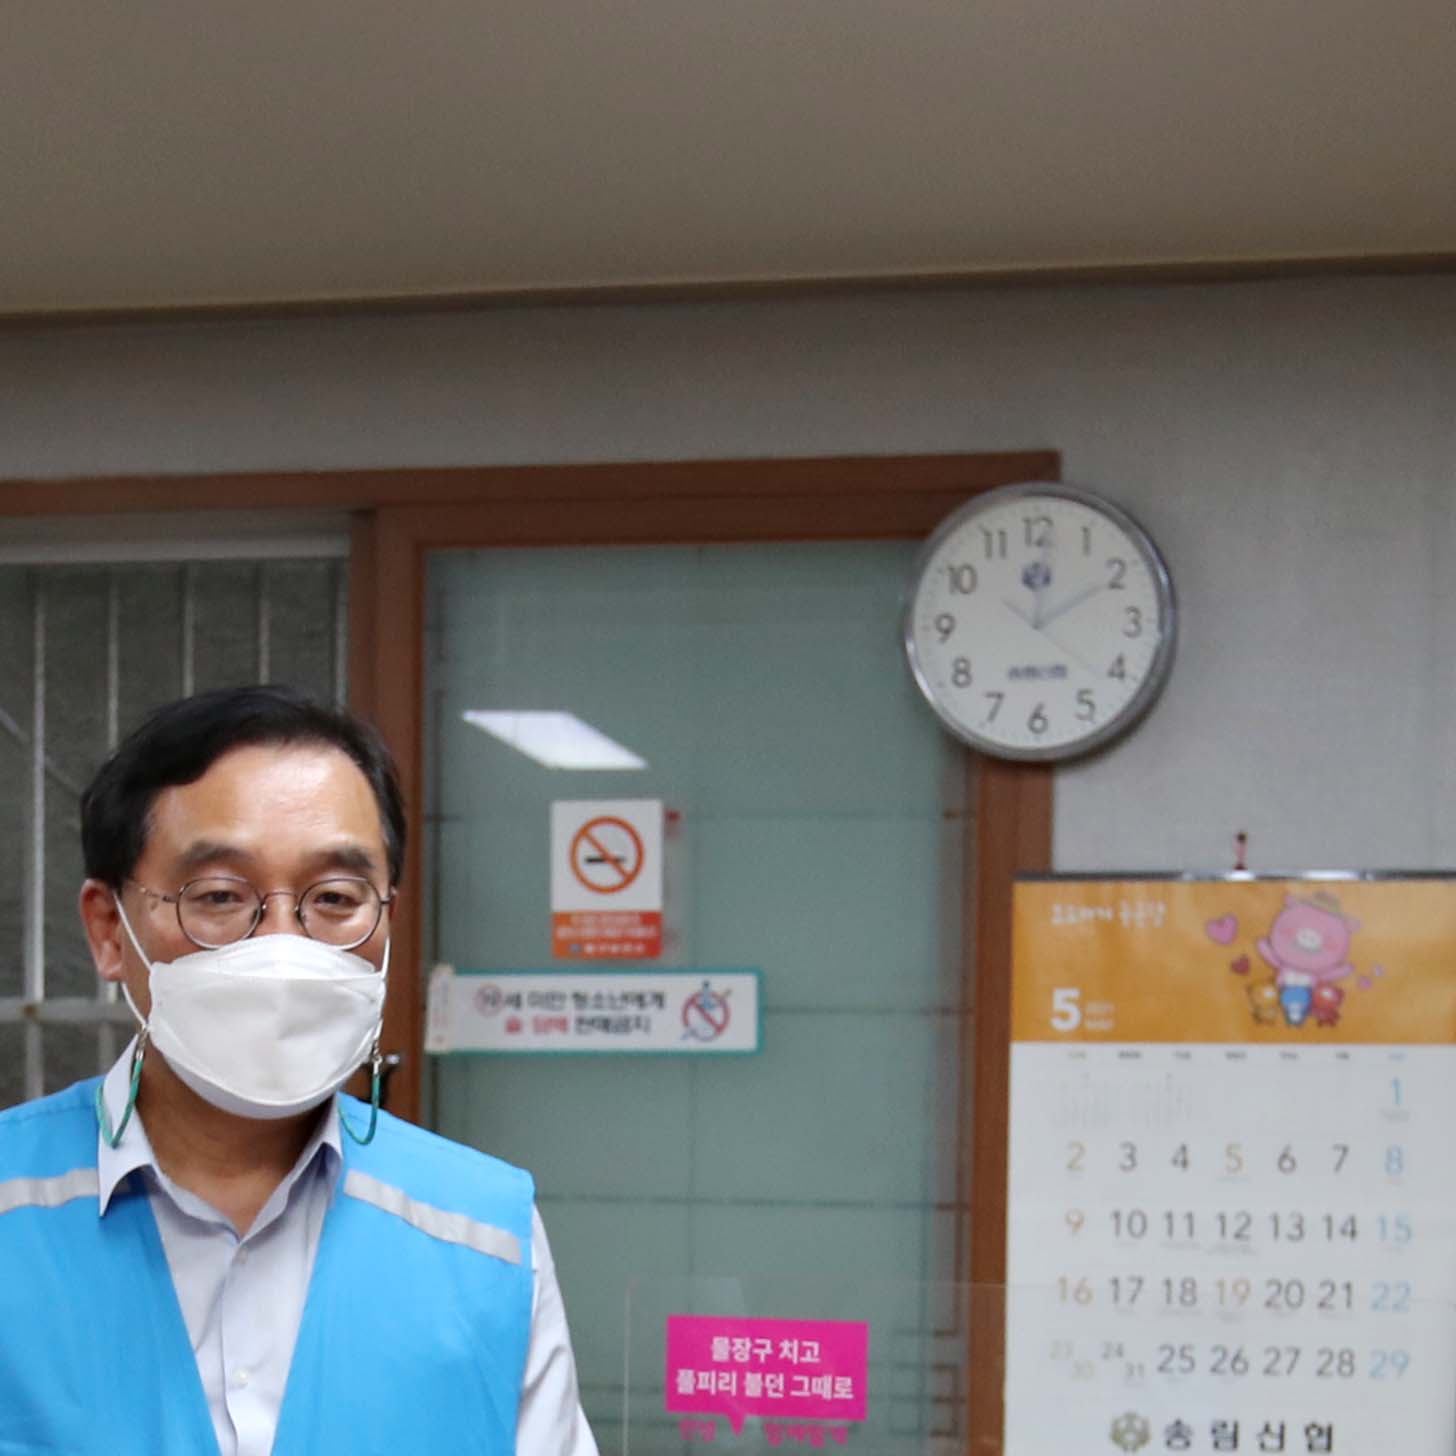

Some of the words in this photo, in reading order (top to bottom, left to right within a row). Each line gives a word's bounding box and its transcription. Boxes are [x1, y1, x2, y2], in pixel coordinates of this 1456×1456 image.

[980, 525, 1007, 559] 11
[1021, 516, 1054, 547] 12
[946, 564, 977, 595] 10
[1106, 558, 1127, 590] 2
[934, 613, 955, 645] 9
[1123, 607, 1142, 638] 3
[952, 658, 973, 688] 8
[1107, 654, 1127, 681] 4
[984, 692, 1006, 724] 7
[1027, 702, 1049, 734] 6
[1075, 690, 1097, 721] 5
[1051, 987, 1082, 1032] 5
[1066, 1140, 1086, 1172] 2
[1119, 1141, 1138, 1173] 3
[1171, 1143, 1190, 1172] 4
[1225, 1143, 1243, 1174] 5
[1278, 1144, 1297, 1174] 6
[1332, 1145, 1349, 1173] 7
[1385, 1145, 1403, 1175] 8
[1065, 1208, 1085, 1235] 9
[1110, 1209, 1147, 1239] 10
[1162, 1211, 1196, 1239] 11
[1216, 1211, 1252, 1241] 12
[1269, 1212, 1304, 1242] 13
[1322, 1213, 1358, 1242] 14
[1377, 1214, 1413, 1243] 15
[1057, 1276, 1094, 1306] 16
[1108, 1276, 1144, 1305] 17
[1162, 1277, 1197, 1307] 18
[1215, 1278, 1251, 1307] 19
[1264, 1278, 1304, 1309] 20
[1316, 1280, 1353, 1310] 21
[1371, 1281, 1411, 1312] 22
[779, 1338, 821, 1364] 치고
[1156, 1343, 1196, 1374] 25
[1209, 1345, 1249, 1376] 26
[1263, 1346, 1301, 1377] 27
[1316, 1348, 1355, 1378] 28
[1369, 1350, 1409, 1379] 29
[743, 1371, 785, 1399] 불던
[791, 1375, 854, 1400] 그때로
